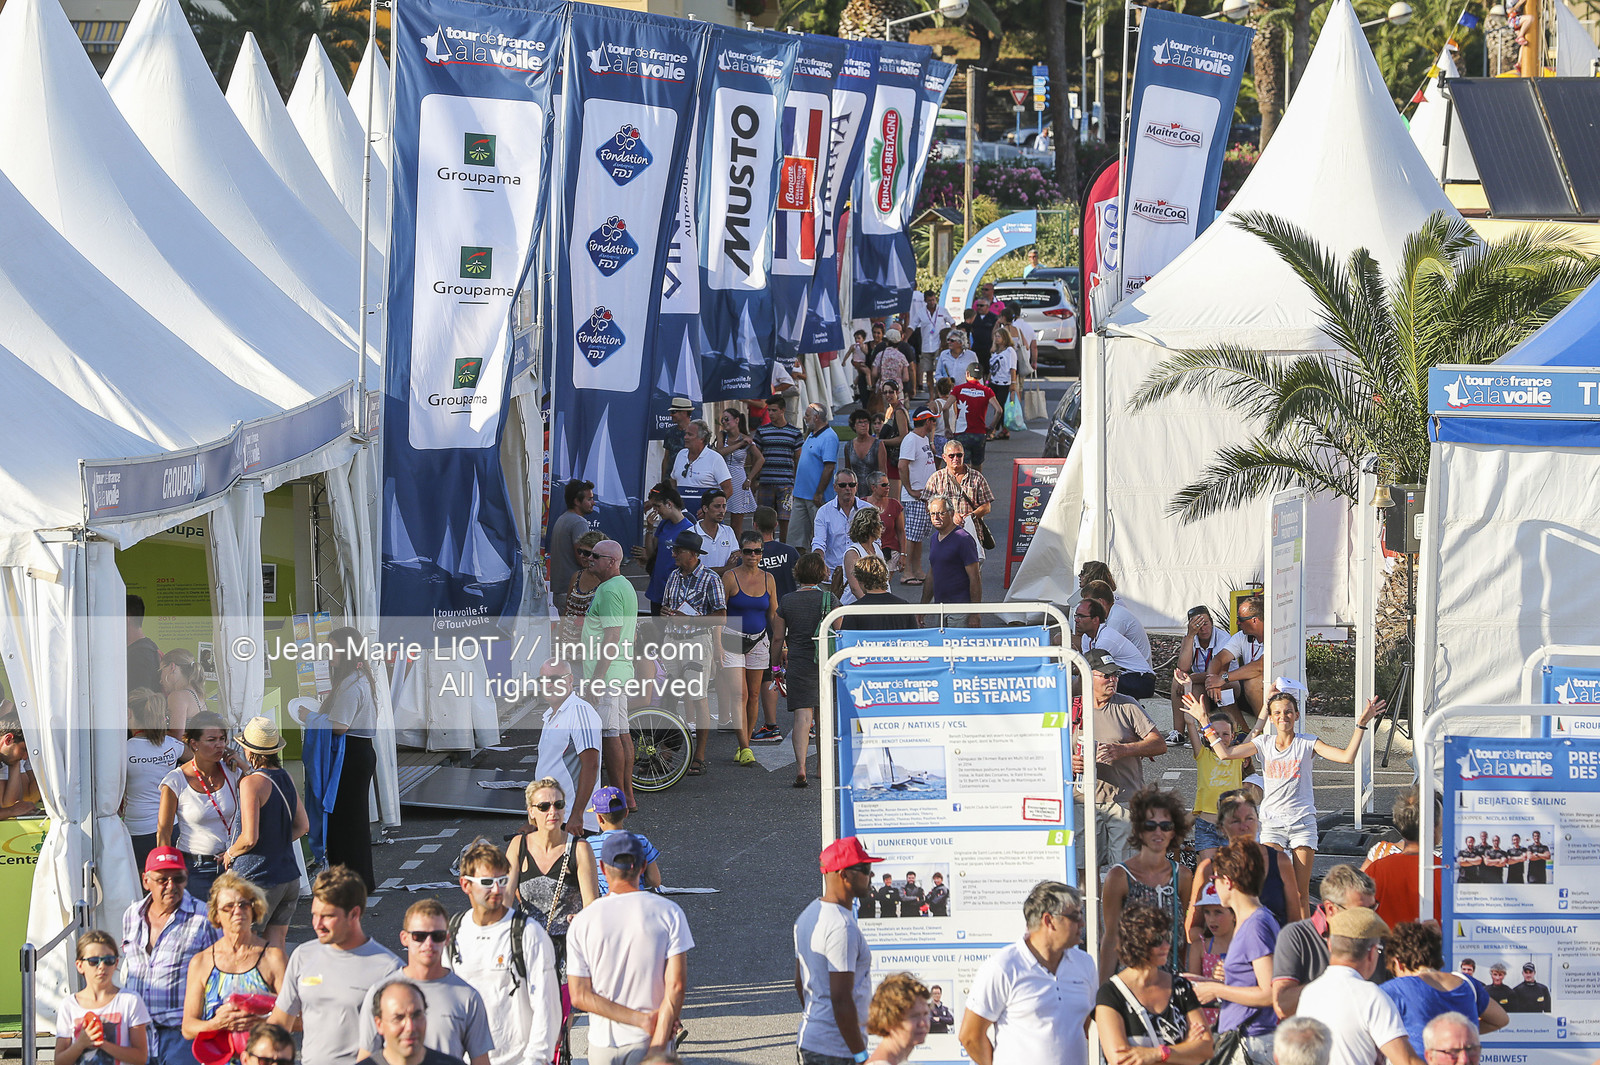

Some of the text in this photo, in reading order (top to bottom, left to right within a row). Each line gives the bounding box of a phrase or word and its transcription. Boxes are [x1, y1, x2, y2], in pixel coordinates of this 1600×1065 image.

[455, 40, 543, 70] à la voile
[613, 56, 685, 80] à la voile
[741, 60, 750, 72] la
[751, 63, 782, 77] voile
[896, 64, 919, 75] voile
[1183, 52, 1193, 67] la
[1195, 57, 1230, 76] voile
[807, 67, 832, 78] voile
[845, 66, 870, 77] voile
[600, 149, 648, 165] Fondation
[882, 113, 896, 209] PRINCE de BRETAGNE
[437, 168, 521, 185] Groupama
[612, 168, 633, 178] FDJ
[785, 162, 798, 203] Banane
[724, 105, 759, 276] MUSTO
[589, 239, 634, 255] Fondation
[598, 259, 619, 269] FDJ
[433, 282, 514, 299] Groupama
[578, 332, 621, 345] Fondation
[587, 349, 605, 359] FDJ
[428, 394, 487, 407] Groupama
[1473, 386, 1552, 404] à la voile
[438, 605, 488, 618] tourvoile.fr
[437, 617, 489, 629] @TourVoile
[953, 676, 1056, 691] PRÉSENTATION
[876, 689, 939, 703] à la voile
[954, 690, 1031, 704] DES TEAMS
[1580, 688, 1590, 702] à
[874, 722, 900, 730] ACCOR
[1050, 715, 1058, 724] 7
[129, 753, 176, 764] Groupama
[1483, 756, 1553, 776] à la voile
[1570, 766, 1597, 779] DES
[1478, 797, 1566, 806] BEIJAFLORE SAILING
[878, 839, 928, 847] DUNKERQUE
[1055, 833, 1063, 843] 8
[0, 855, 38, 865] Centa
[1476, 925, 1578, 935] CHEMINÉES POUJOULAT
[881, 955, 930, 963] DYNAMIQUE
